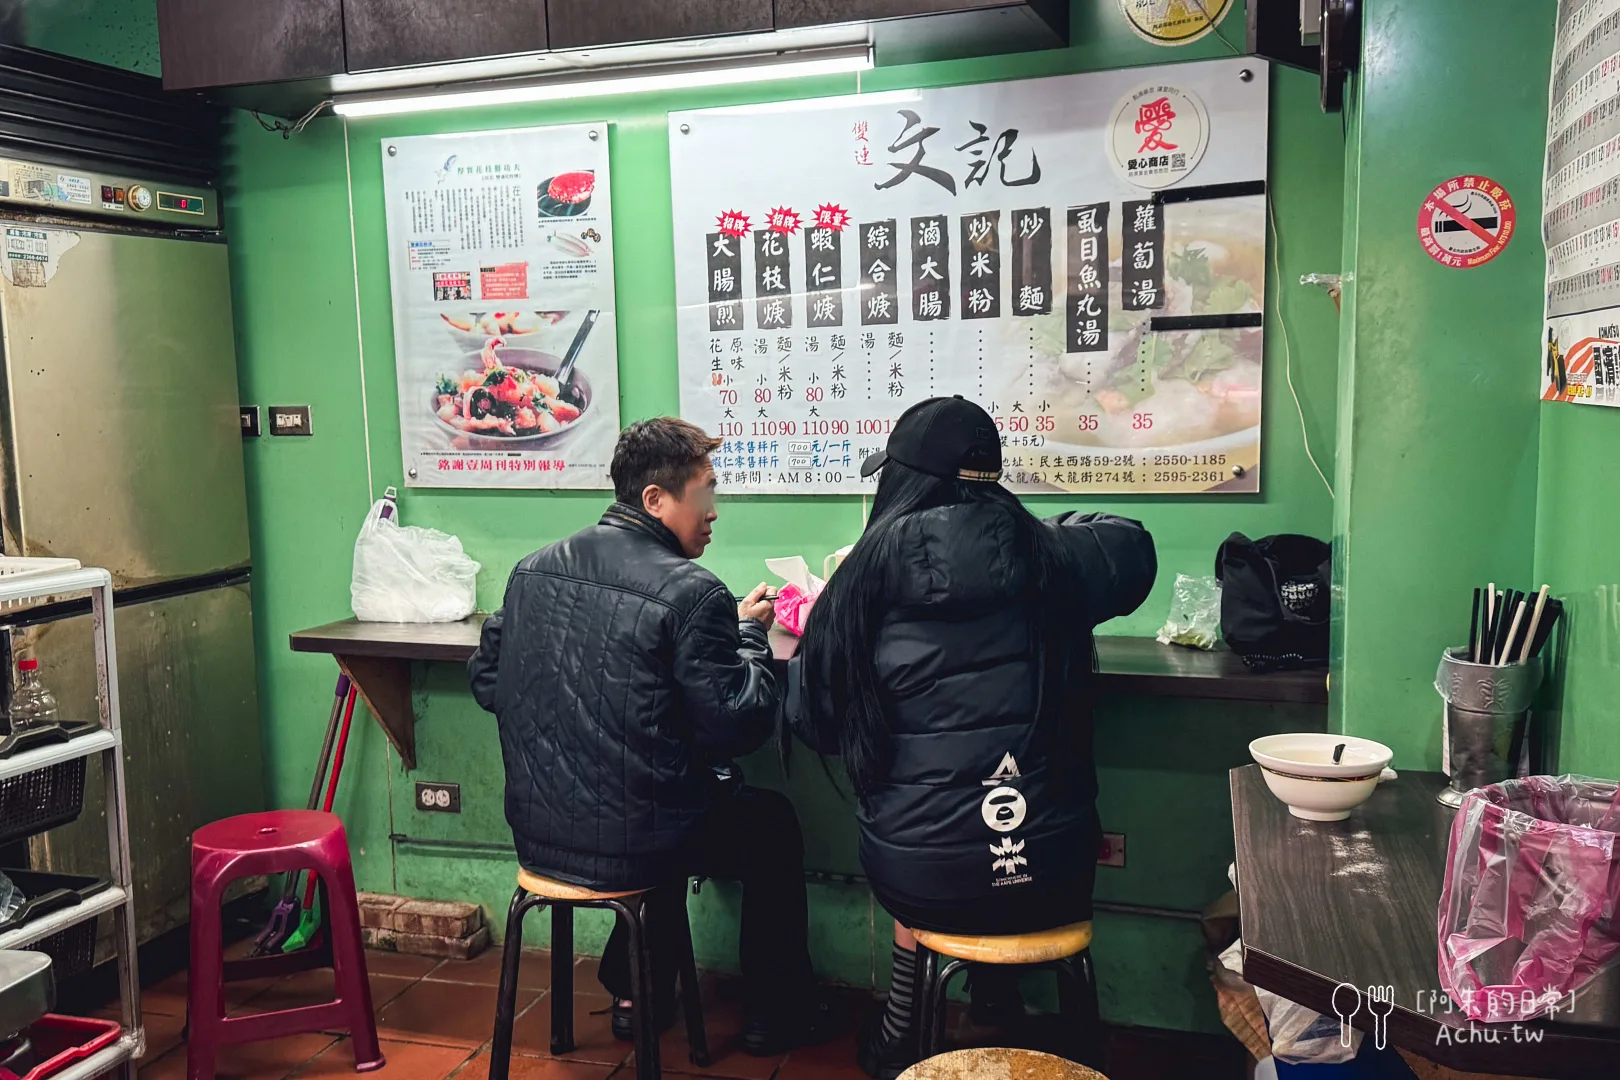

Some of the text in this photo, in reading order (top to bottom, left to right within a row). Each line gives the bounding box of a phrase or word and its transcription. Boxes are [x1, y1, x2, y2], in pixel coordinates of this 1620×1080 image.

[852, 120, 873, 166] 雙連
[874, 110, 1041, 196] 文記
[1128, 155, 1169, 170] 愛心商店
[722, 216, 745, 231] 招牌
[772, 212, 795, 228] 招牌
[819, 209, 843, 226] 限量
[1019, 212, 1045, 311] 炒麵
[1132, 203, 1158, 307] 蘿蔔湯
[918, 219, 943, 316] 滷大腸
[968, 215, 994, 314] 炒米粉
[712, 234, 736, 326] 大腸煎
[761, 231, 786, 325] 花枝焿
[811, 228, 836, 321] 蝦仁焿
[1076, 206, 1102, 346] 虱目魚丸湯
[754, 338, 769, 355] 湯
[804, 336, 820, 352] 湯
[860, 332, 875, 349] 湯
[709, 338, 723, 371] 花生
[730, 338, 745, 371] 原味
[776, 336, 794, 401] 麵/米粉
[830, 334, 848, 399] 麵/米粉
[887, 332, 905, 398] 麵/米粉
[723, 374, 733, 386] 小
[756, 373, 767, 386] 小
[808, 372, 819, 384] 小
[719, 389, 738, 405] 70
[754, 388, 772, 403] 80
[805, 386, 824, 402] 80
[724, 407, 735, 419] 大
[757, 406, 768, 418] 大
[809, 405, 820, 417] 大
[987, 401, 999, 413] 小
[1012, 401, 1024, 413] 大
[1038, 400, 1050, 413] 小
[718, 421, 743, 436] 110
[751, 421, 777, 436] 110
[779, 420, 796, 436] 90
[802, 420, 829, 435] 110
[831, 420, 849, 435] 90
[856, 419, 882, 435] 100
[1009, 416, 1029, 432] 50
[1036, 415, 1055, 431] 35
[1078, 414, 1098, 431] 35
[1132, 413, 1153, 429] 35
[790, 443, 809, 451] 700
[791, 458, 807, 466] 700
[1154, 454, 1226, 466] 2550-1185
[777, 472, 799, 484] AM
[1154, 472, 1224, 482] 2595-2361
